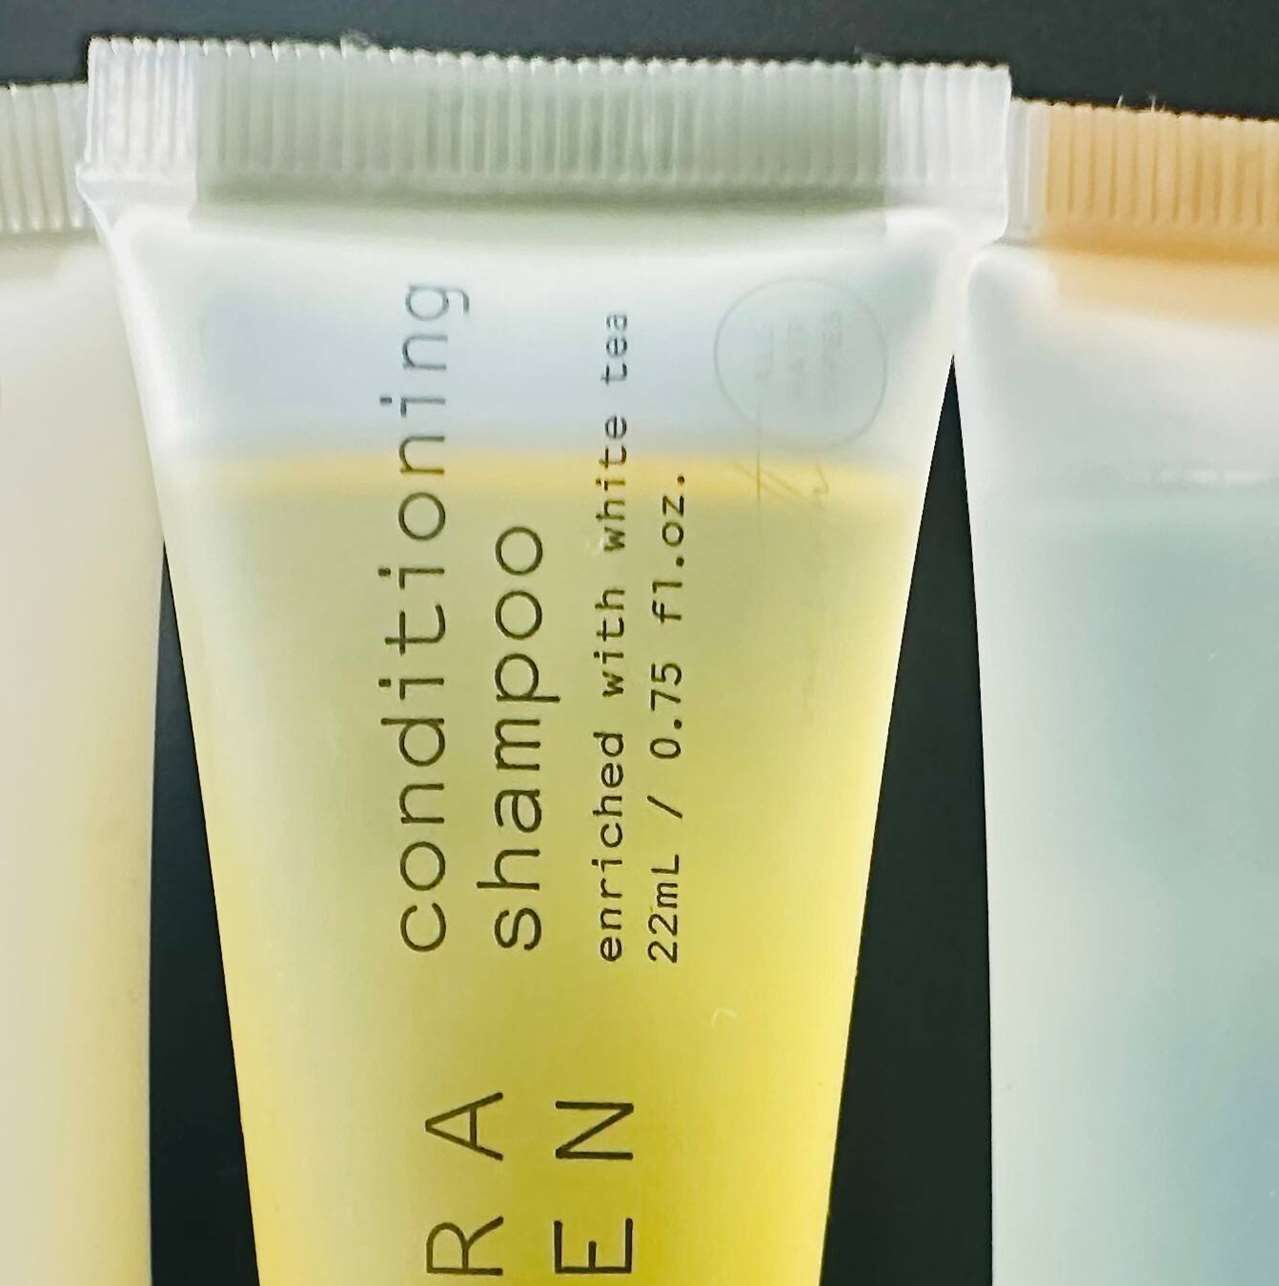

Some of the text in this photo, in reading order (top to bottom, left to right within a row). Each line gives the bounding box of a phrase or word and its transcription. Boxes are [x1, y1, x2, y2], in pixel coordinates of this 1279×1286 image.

[378, 283, 469, 952] conditioning
[477, 526, 561, 951] shampoo
[592, 311, 629, 963] enriched with white tea
[647, 472, 686, 963] 22mL / 0.75 fl.oz.
